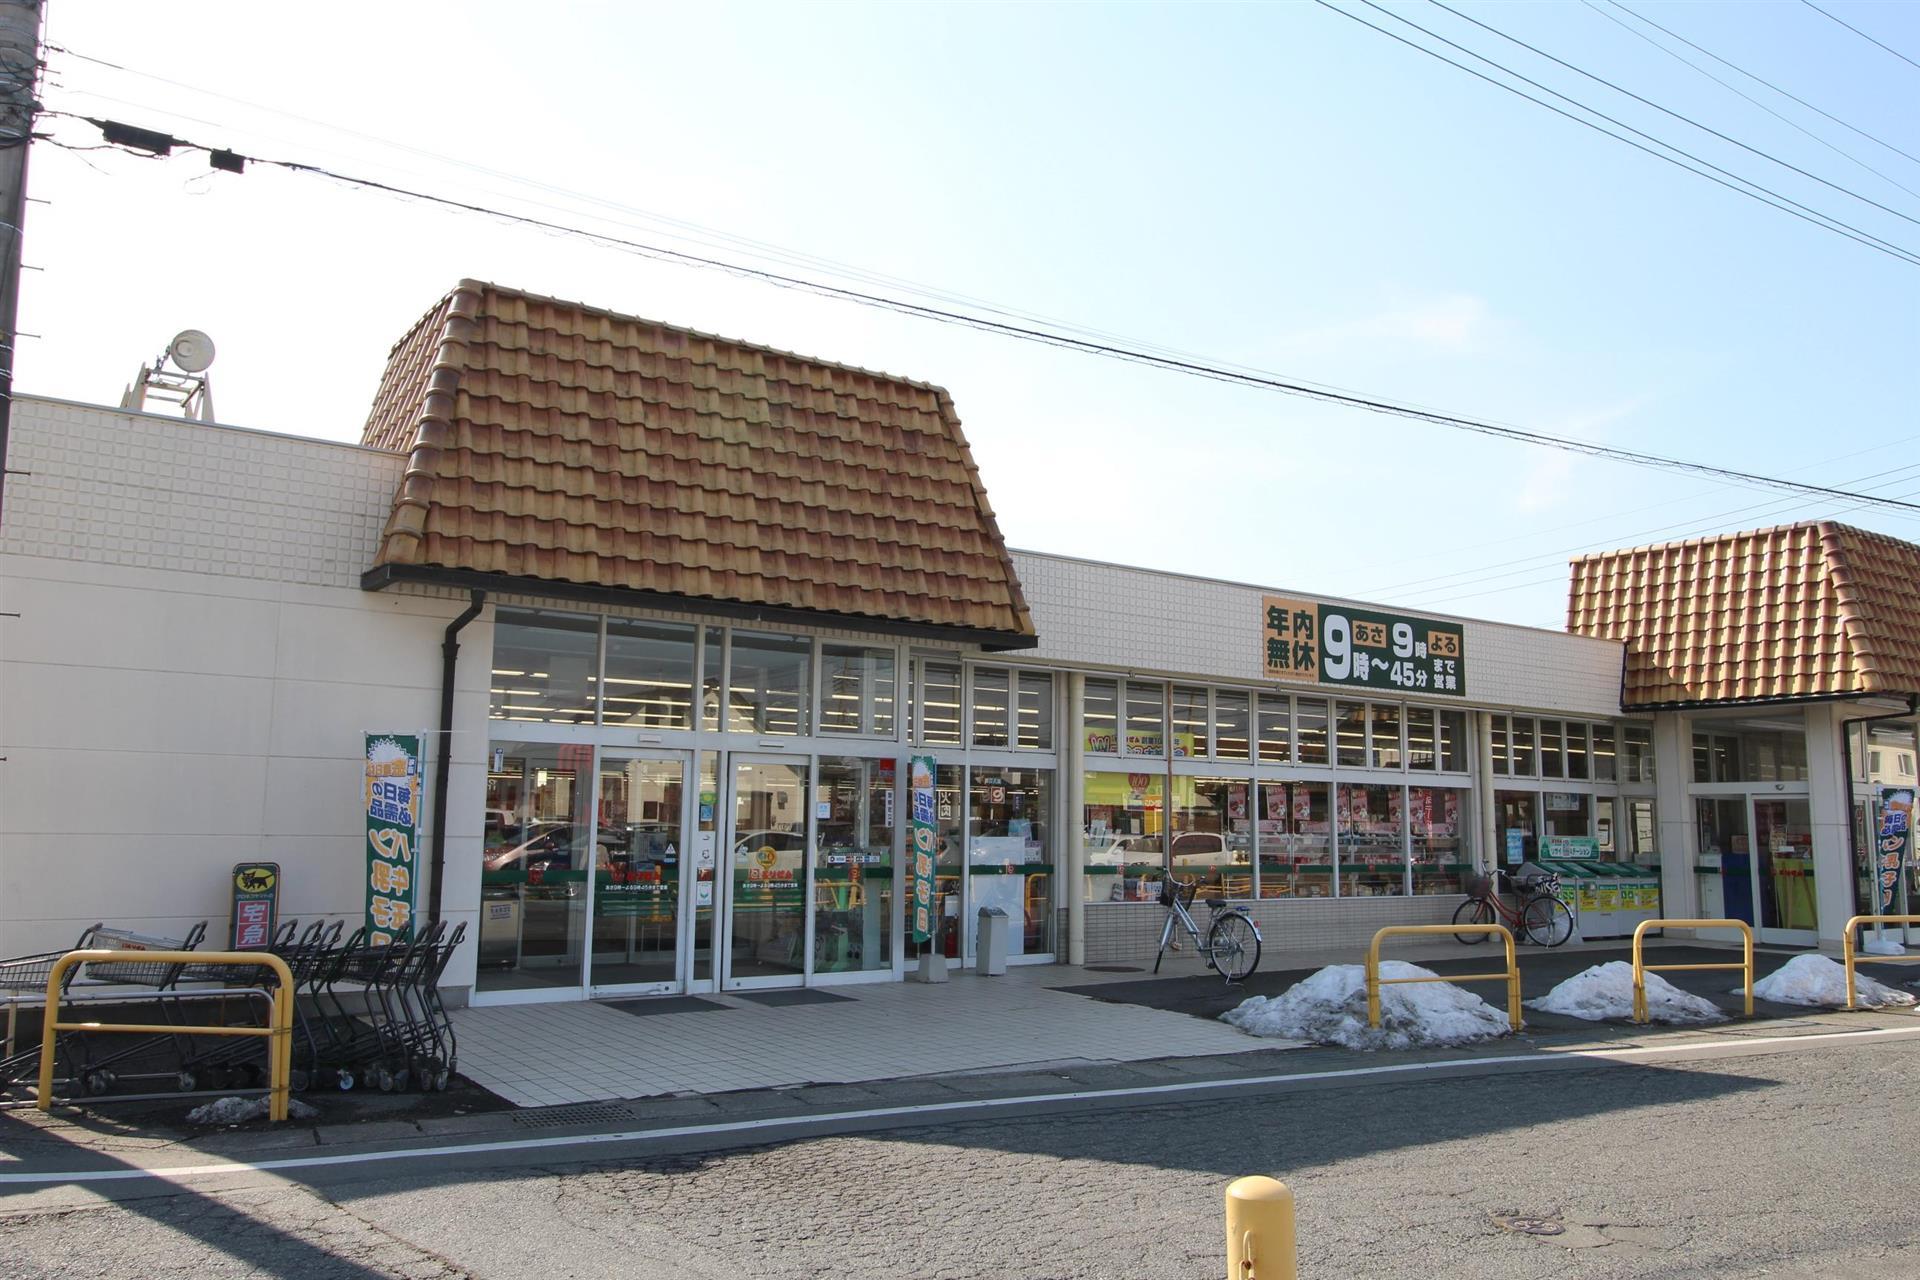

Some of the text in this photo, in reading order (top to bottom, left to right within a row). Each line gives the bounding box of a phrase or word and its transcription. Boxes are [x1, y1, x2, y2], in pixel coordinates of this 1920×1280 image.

[1267, 605, 1314, 640] 年内
[1356, 624, 1383, 643] あさ
[1267, 637, 1315, 671] 無休
[1431, 635, 1456, 653] よる
[1390, 661, 1427, 687] 45分
